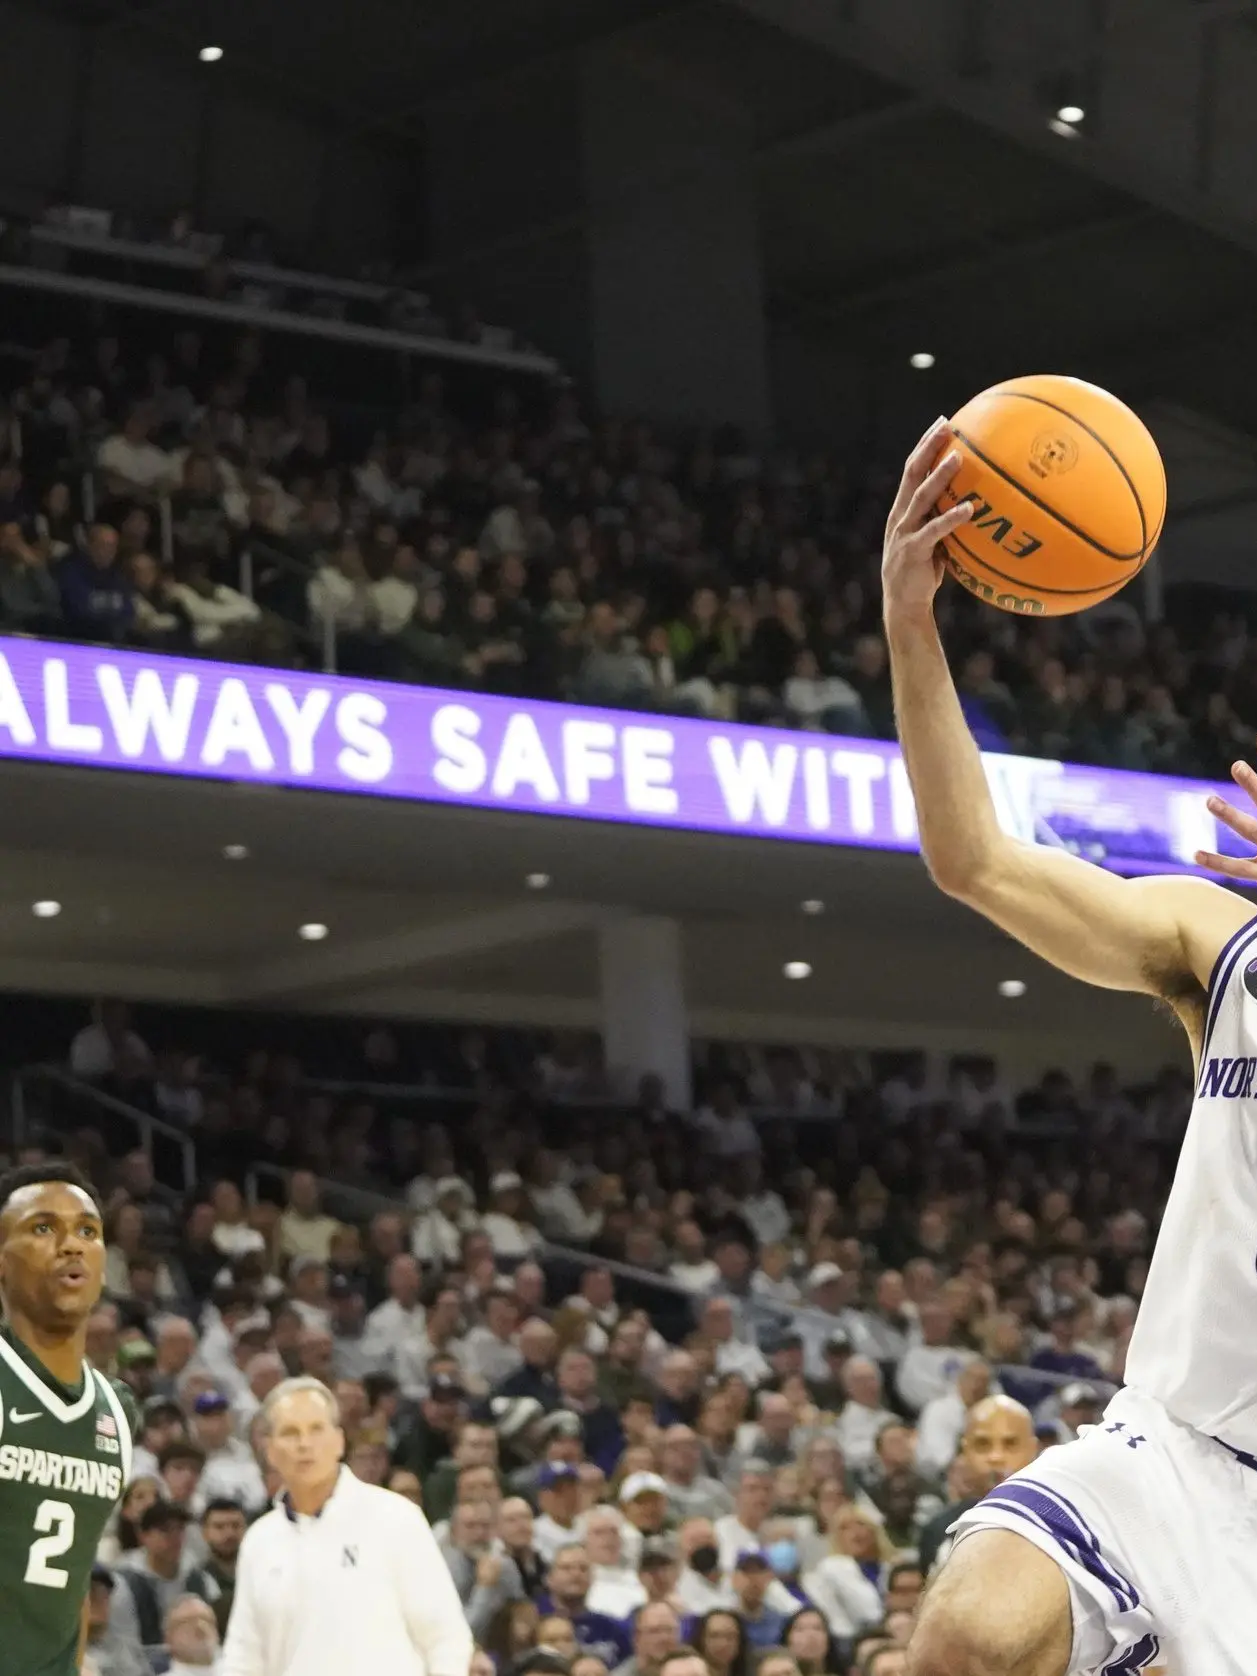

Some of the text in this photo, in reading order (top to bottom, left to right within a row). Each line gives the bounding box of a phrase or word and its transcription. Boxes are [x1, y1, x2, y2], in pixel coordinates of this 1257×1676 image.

[430, 704, 679, 815] SAFE
[0, 1444, 122, 1500] SPARTANS
[23, 1499, 76, 1589] 2
